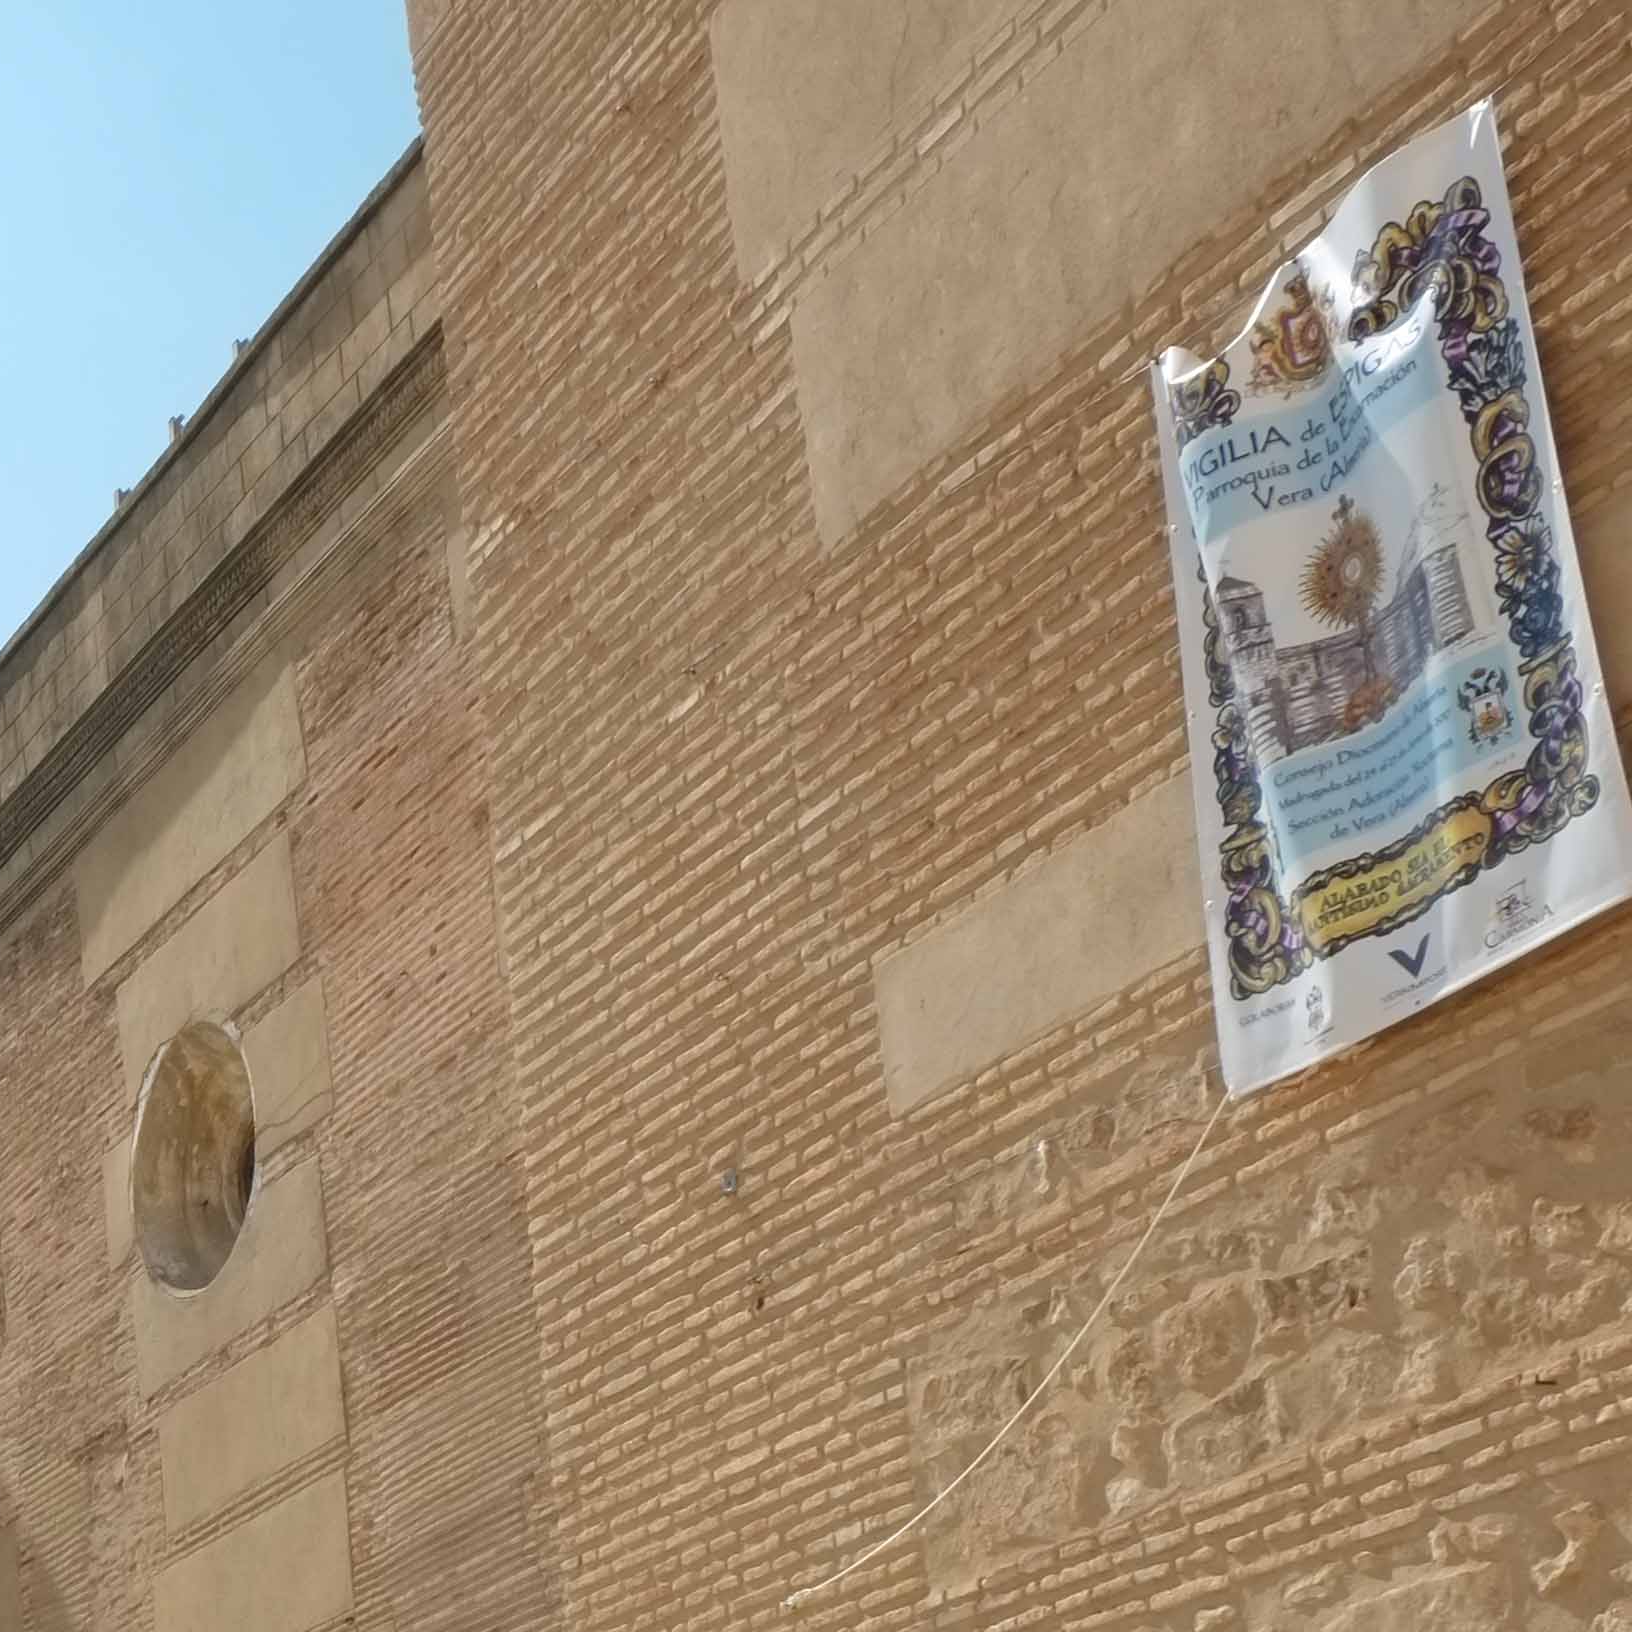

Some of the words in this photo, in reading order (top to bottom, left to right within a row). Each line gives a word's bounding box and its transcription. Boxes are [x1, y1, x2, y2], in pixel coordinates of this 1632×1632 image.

[1300, 418, 1326, 442] de
[1191, 460, 1290, 512] Parroquia
[1296, 448, 1323, 471] de
[1251, 486, 1313, 510] Vera
[1320, 868, 1402, 912] ALABADO
